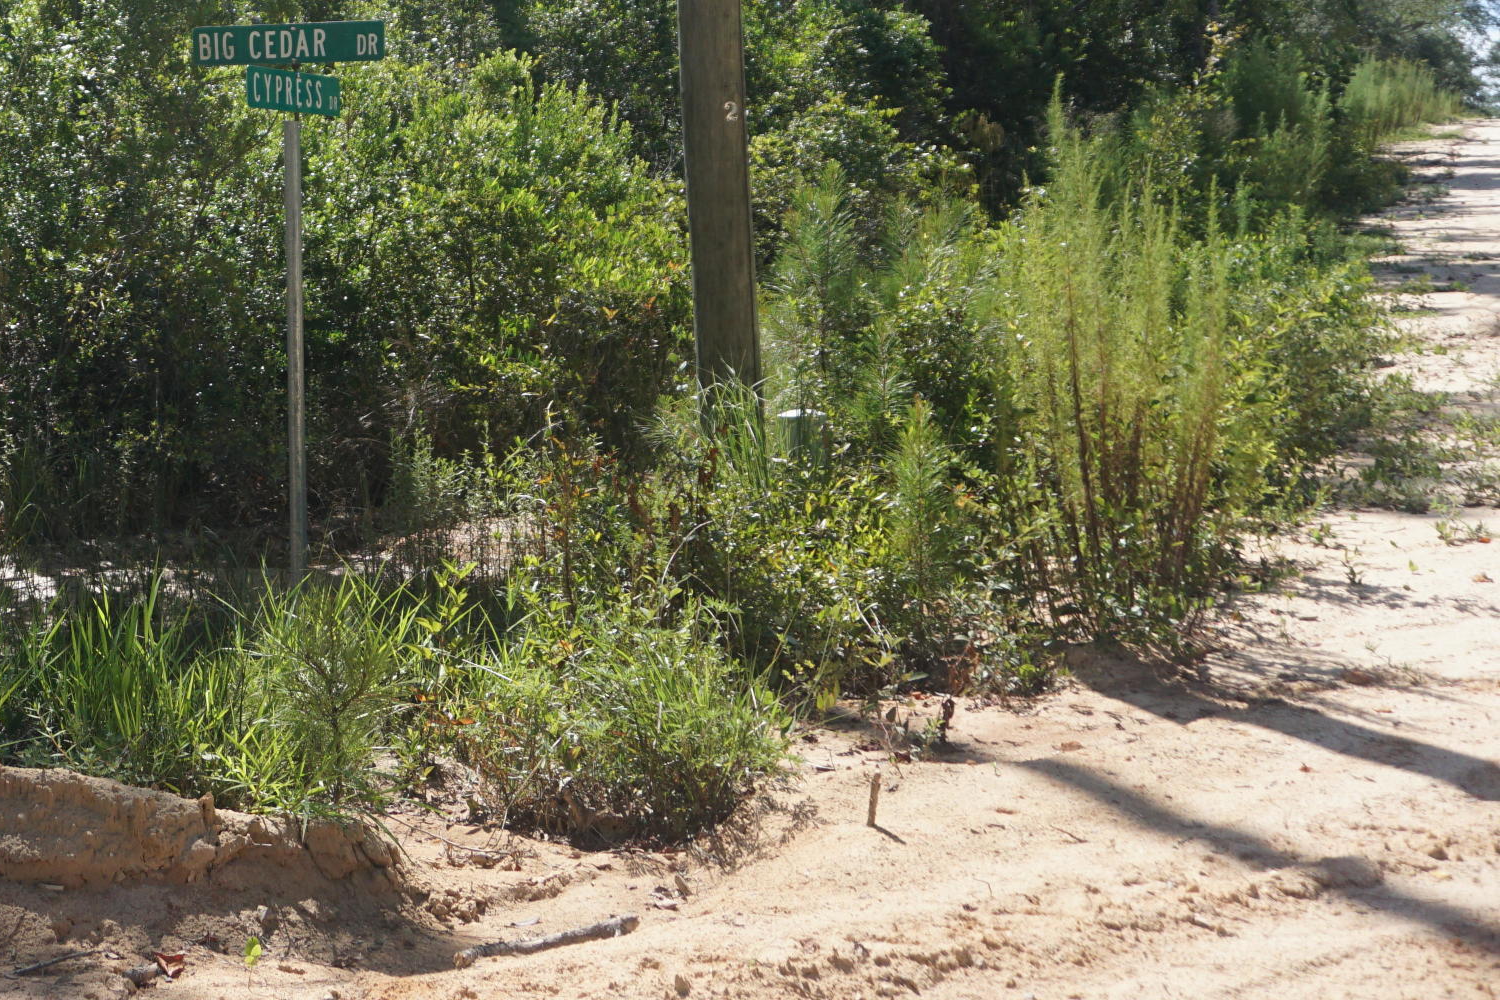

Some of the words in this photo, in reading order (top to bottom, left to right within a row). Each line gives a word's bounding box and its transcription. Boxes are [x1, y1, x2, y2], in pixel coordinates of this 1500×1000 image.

[199, 32, 235, 61] BIG
[249, 28, 327, 60] CEDAR
[356, 33, 378, 56] DR
[253, 72, 322, 110] CYPRESS
[328, 95, 338, 111] DR
